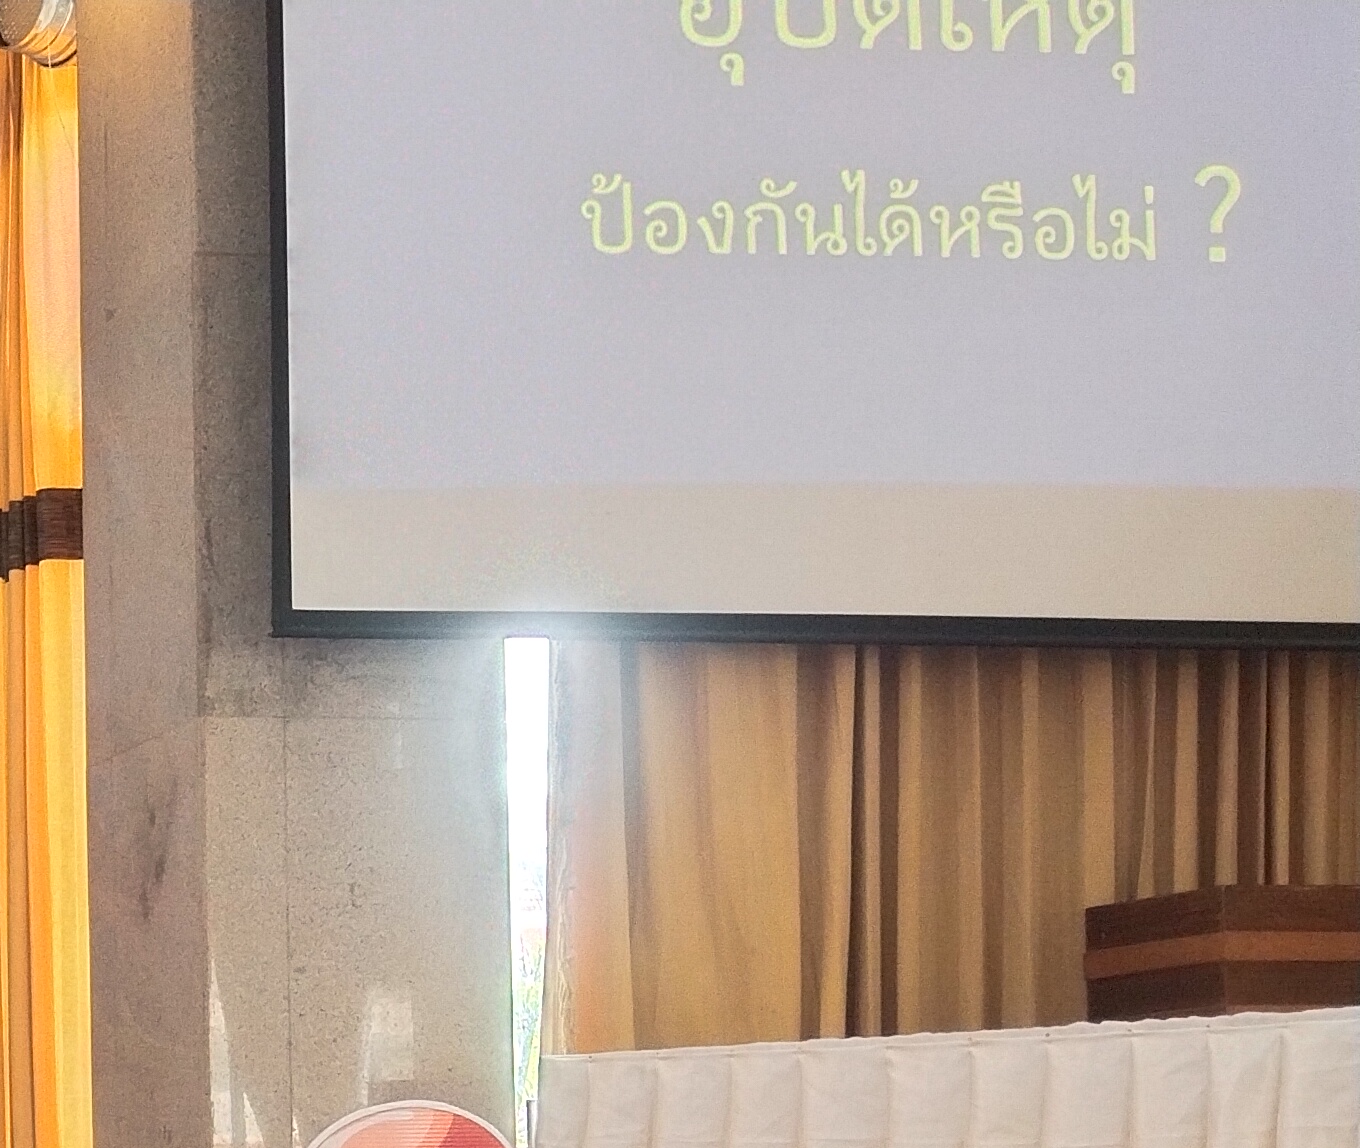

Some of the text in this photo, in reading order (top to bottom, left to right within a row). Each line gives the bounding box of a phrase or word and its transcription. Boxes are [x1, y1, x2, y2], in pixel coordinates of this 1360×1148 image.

[581, 164, 1242, 262] ป้องกันได้หรือไม่ ?
